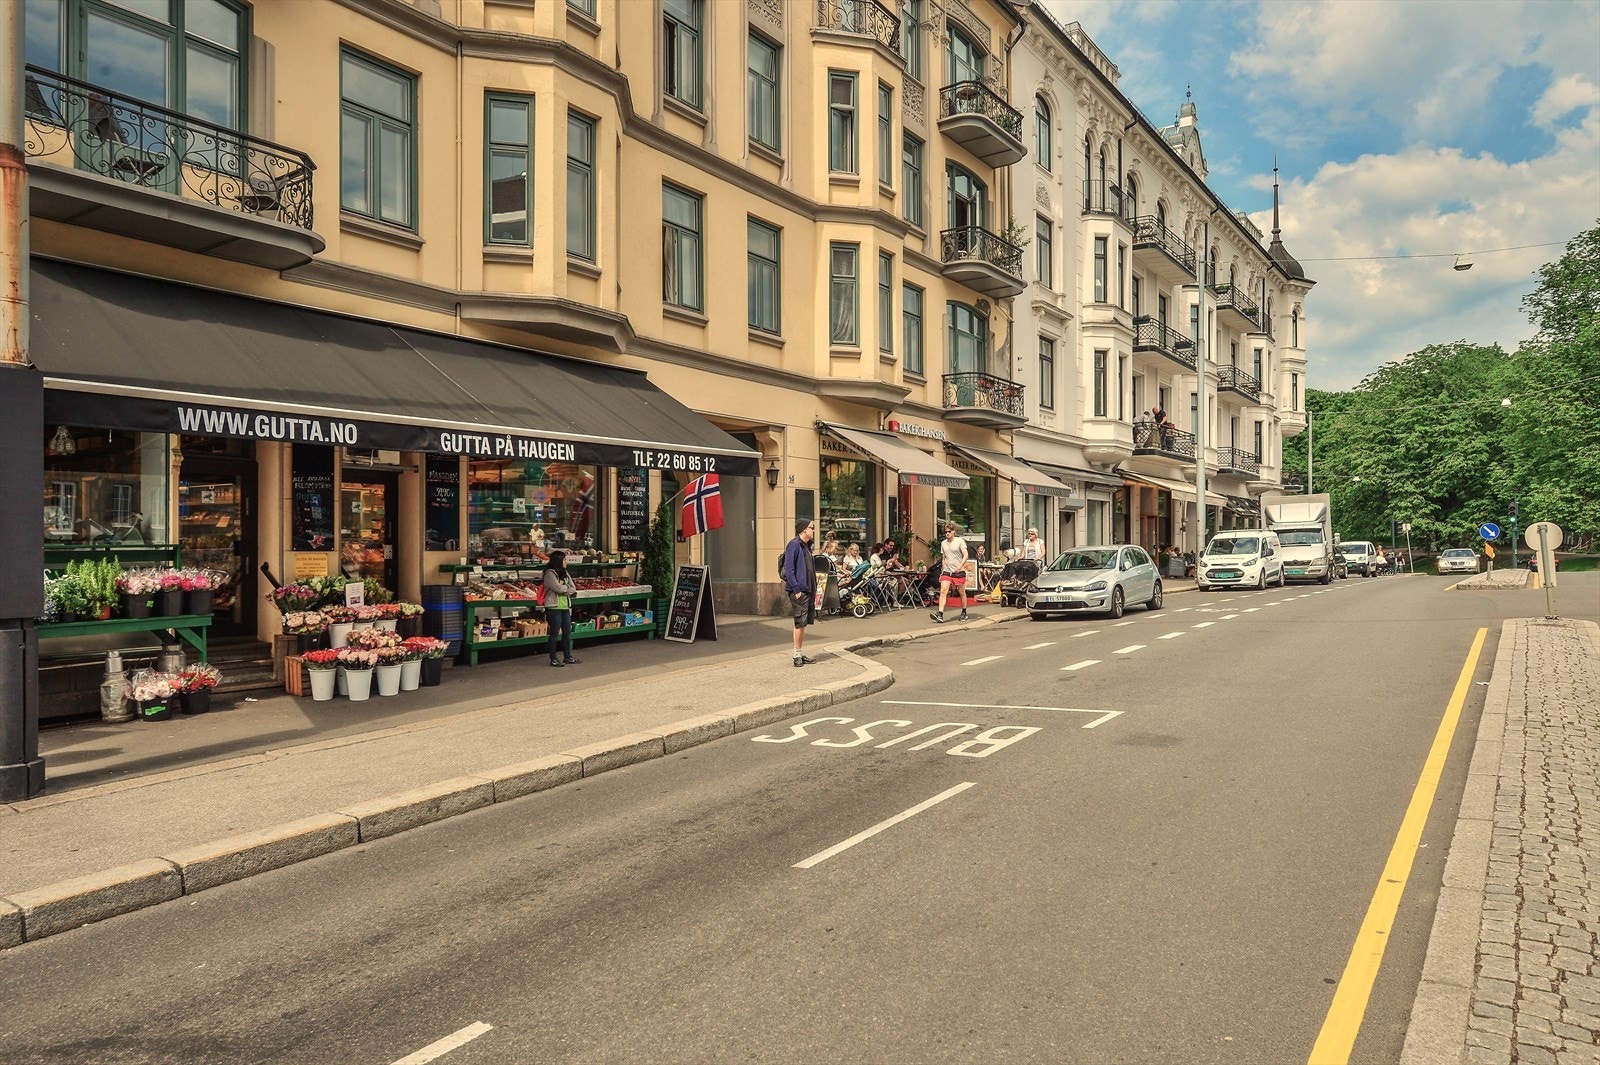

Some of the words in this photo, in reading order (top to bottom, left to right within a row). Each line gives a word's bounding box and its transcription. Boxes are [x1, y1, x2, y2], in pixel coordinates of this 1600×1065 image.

[177, 407, 358, 445] WWW.GUTTA.NO
[441, 432, 491, 455] GUTTA
[496, 435, 514, 457] PÅ
[519, 440, 575, 461] HAUGEN
[821, 439, 848, 453] BAKER
[633, 450, 655, 468] TLF.
[658, 452, 671, 469] 22
[673, 454, 686, 470] 60
[689, 455, 701, 471] 85
[703, 457, 716, 472] 12
[751, 716, 1044, 758] BUSS
